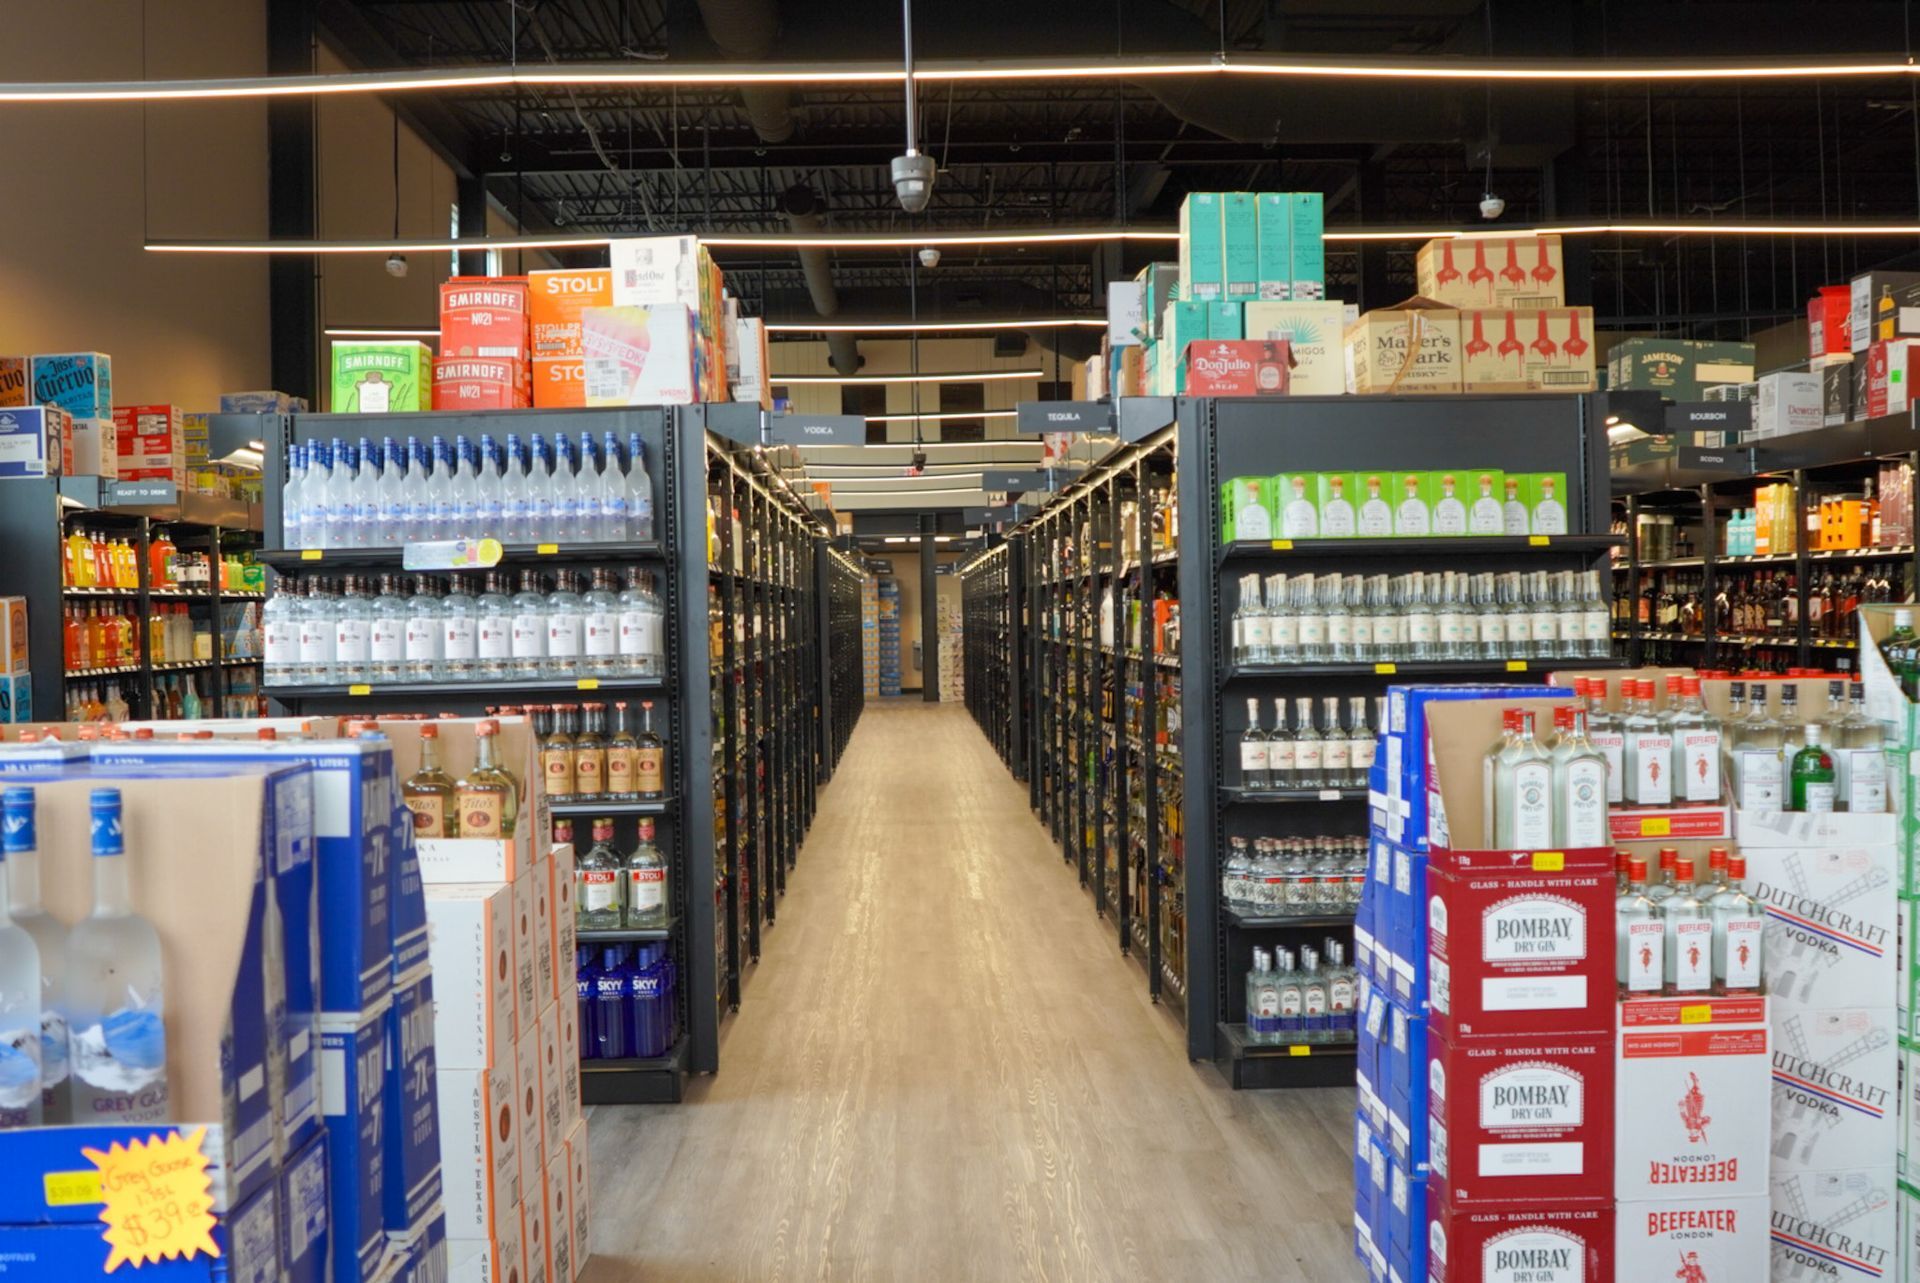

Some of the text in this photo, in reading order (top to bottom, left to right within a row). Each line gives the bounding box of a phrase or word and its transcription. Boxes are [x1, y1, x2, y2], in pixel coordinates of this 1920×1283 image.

[547, 277, 603, 294] STOLI
[449, 292, 516, 308] SMIRNOFF
[1377, 335, 1452, 350] Maer's
[345, 355, 404, 369] SMIRNOFF
[1641, 352, 1684, 365] JAMESON
[436, 364, 505, 380] SMIRNOFF
[34, 365, 95, 403] Cuervo
[1047, 412, 1081, 422] TEQUILA
[1690, 412, 1727, 421] BOURBON
[803, 426, 834, 435] VODKA
[1700, 455, 1724, 464] SCOTCH
[117, 489, 137, 497] READY
[150, 488, 168, 496] DRINK
[1639, 735, 1672, 749] BEEFEATER
[1686, 735, 1718, 747] BEEFEATER
[464, 797, 494, 810] Tito's
[588, 872, 610, 882] STOLI
[639, 871, 661, 881] STOLI
[1470, 877, 1598, 890] GLASS HANDLE WITH CARE
[1755, 881, 1890, 945] DUTCHCRAFT
[1495, 917, 1573, 942] BOMBAY
[1630, 923, 1664, 935] BEEFEATER
[1678, 923, 1711, 935] BEEFEATER
[1728, 921, 1761, 932] BEEFEATER
[1514, 940, 1556, 953] DRY GIN
[1785, 926, 1840, 956] VODKA
[598, 980, 623, 991] SKYY
[633, 979, 658, 990] SKYY
[1467, 1046, 1596, 1058] GLASS HANDLE WITH CARE
[1772, 1050, 1890, 1107] UTCHCRAFT
[1492, 1085, 1570, 1109] BOMBAY
[1785, 1088, 1840, 1118] VODKA
[93, 1095, 135, 1113] GREY
[1511, 1107, 1553, 1120] DRY GIN
[473, 1088, 483, 1225] AUSTIN TEXAS
[1672, 1154, 1716, 1163] LONDON
[105, 1156, 194, 1193] Grey Goose
[1651, 1158, 1737, 1184] BEEFEATER
[1471, 1211, 1599, 1222] GLASS HANDLE WITH CARE
[1648, 1210, 1737, 1237] BEEFEATER
[1671, 1231, 1714, 1240] LONDON
[1771, 1210, 1889, 1266] UTCHCRAFT
[1494, 1249, 1572, 1273] BOMBAY
[1784, 1248, 1839, 1277] VODKA
[1513, 1271, 1555, 1283] DRY GIN
